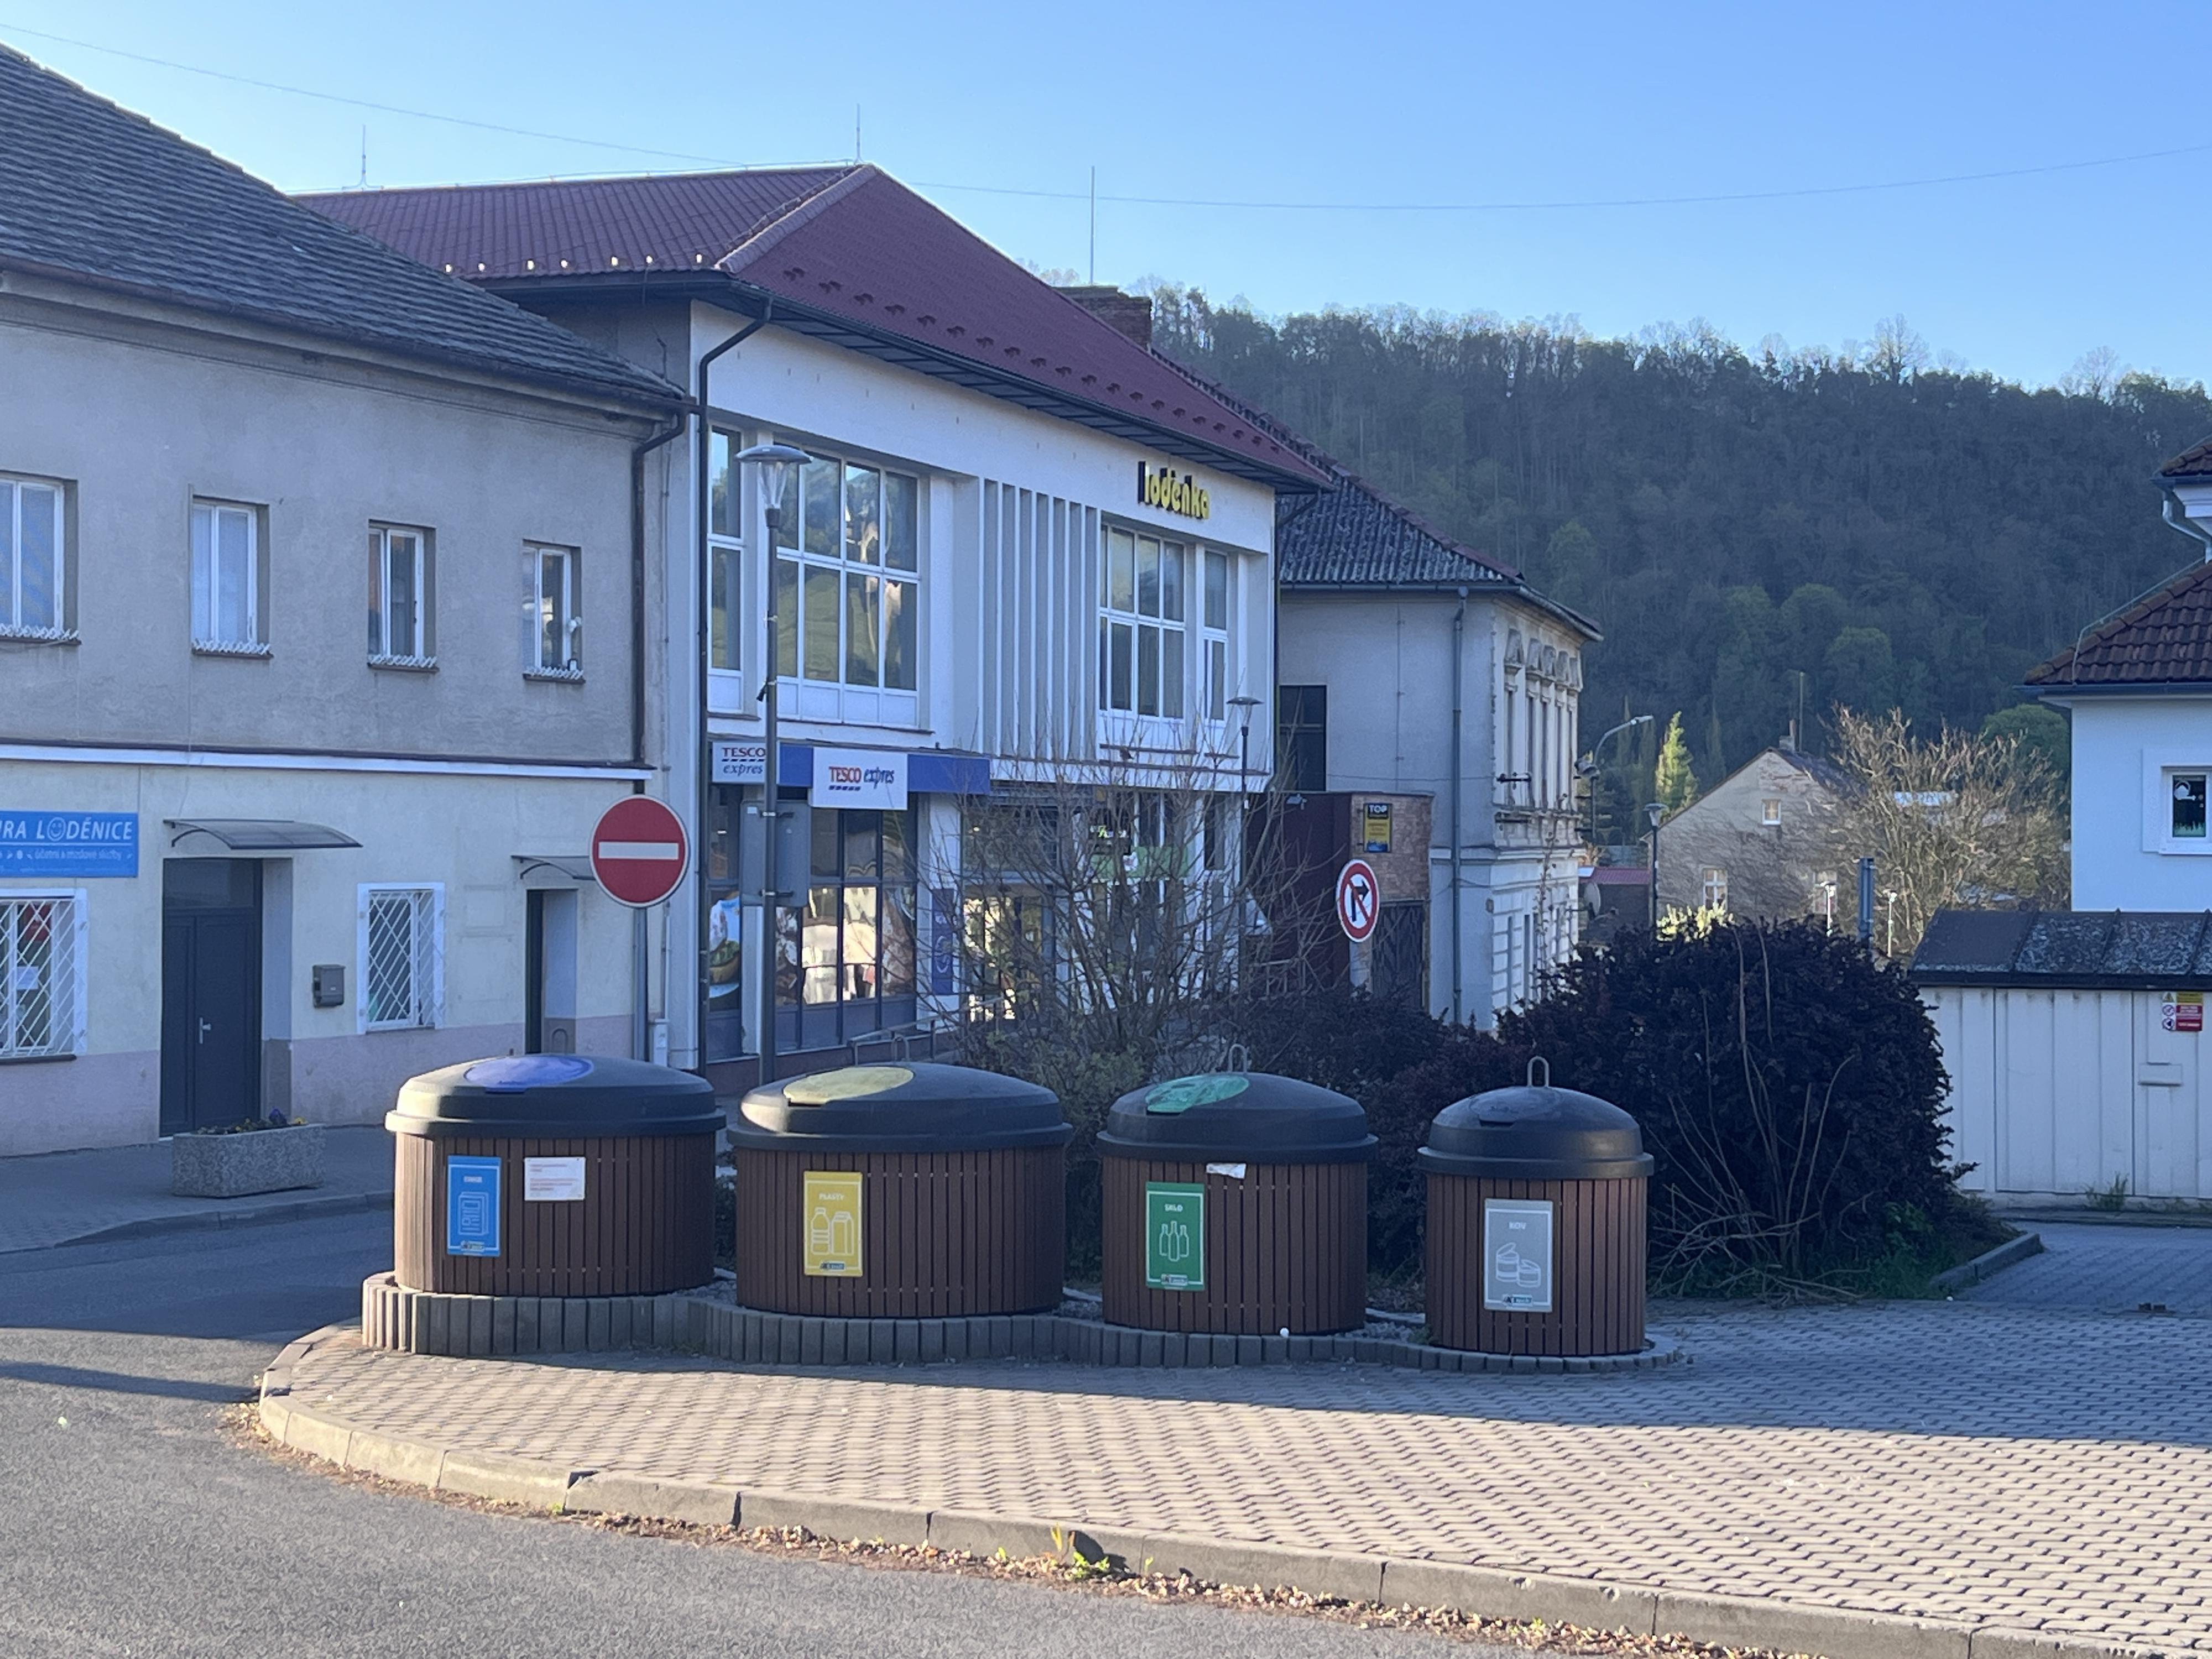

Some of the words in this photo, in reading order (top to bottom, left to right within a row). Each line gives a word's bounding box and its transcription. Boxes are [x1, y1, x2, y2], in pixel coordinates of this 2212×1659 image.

[722, 747, 766, 757] TESCO
[723, 764, 763, 777] expres
[828, 766, 862, 784] TESCO
[863, 766, 895, 790] expres
[0, 820, 27, 839] RA
